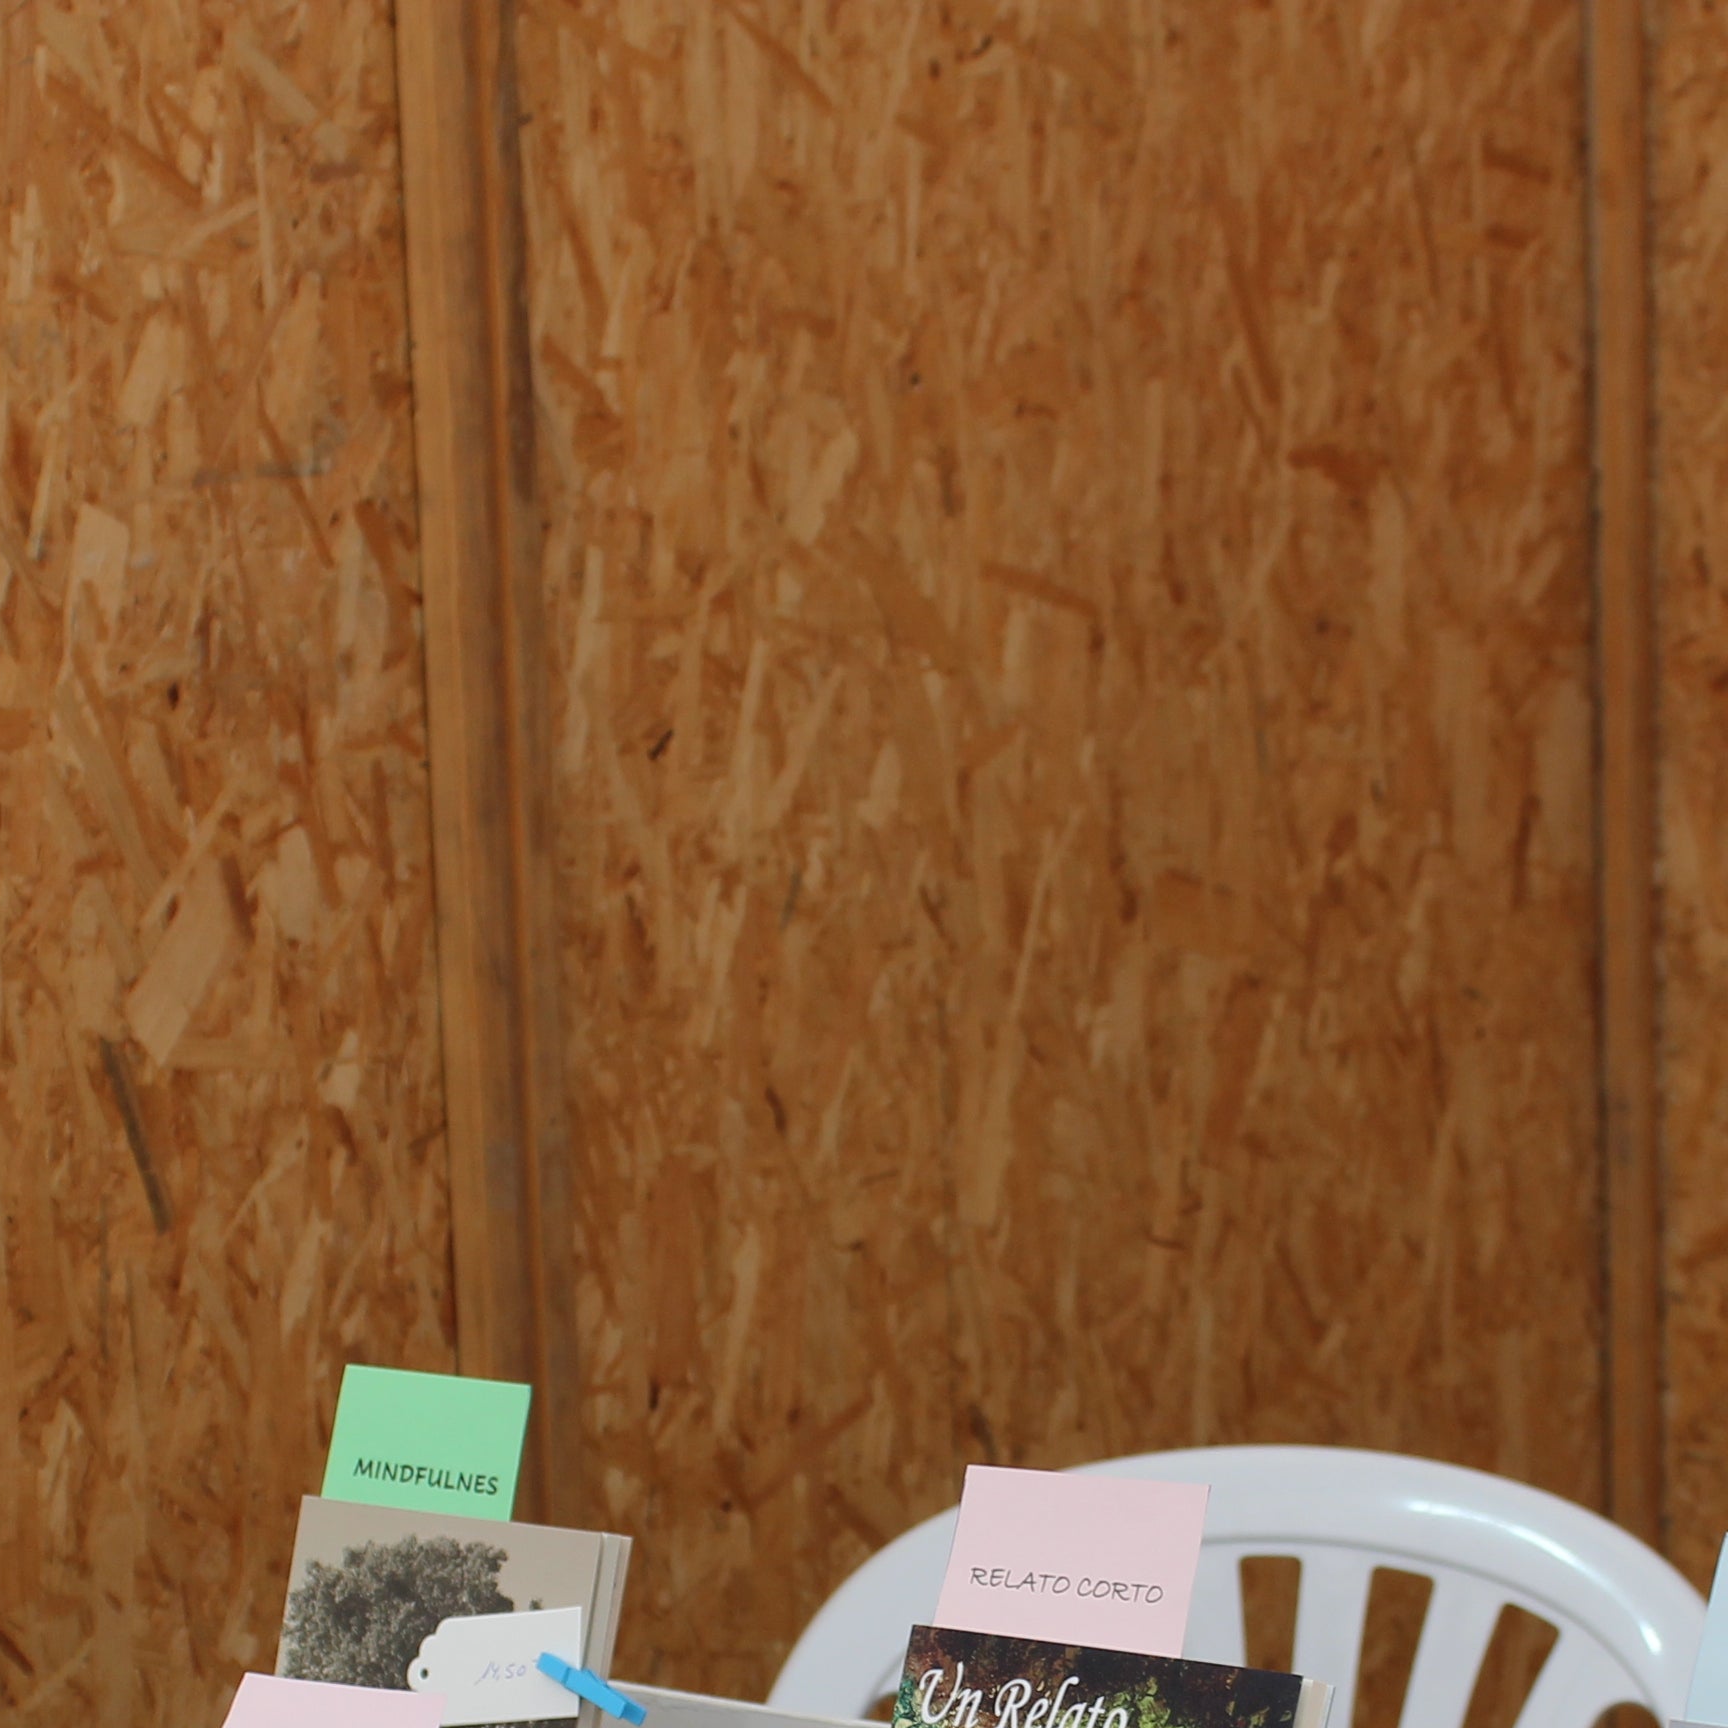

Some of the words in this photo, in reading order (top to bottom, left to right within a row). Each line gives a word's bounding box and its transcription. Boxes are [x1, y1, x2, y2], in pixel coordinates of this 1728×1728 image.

[352, 1457, 500, 1496] MINDFULNES
[968, 1564, 1071, 1600] RELATO
[1076, 1576, 1165, 1606] CORTO
[916, 1664, 984, 1728] Un
